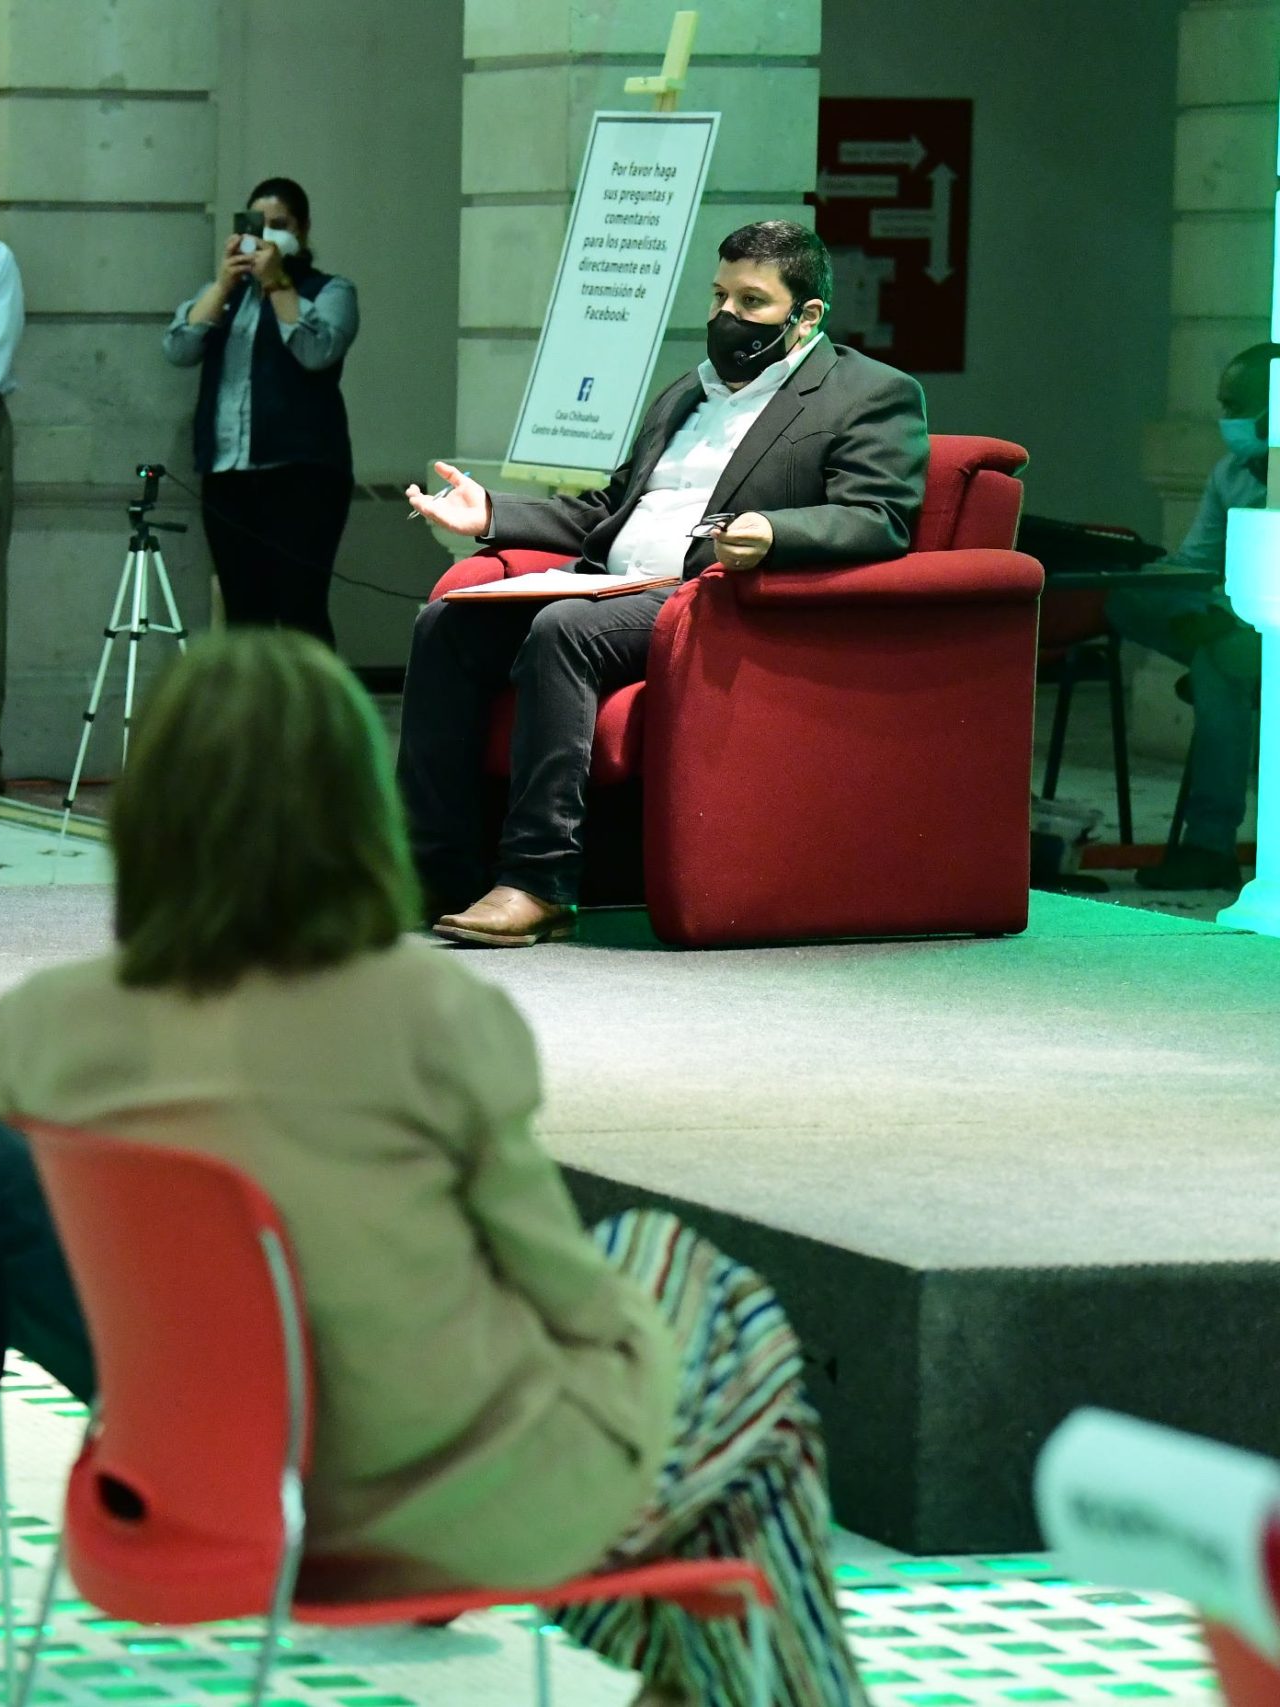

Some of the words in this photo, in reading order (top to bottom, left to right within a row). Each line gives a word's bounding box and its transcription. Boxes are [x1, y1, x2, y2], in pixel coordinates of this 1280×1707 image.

[611, 162, 627, 176] Por
[628, 162, 653, 177] favor
[654, 163, 677, 181] haga
[603, 189, 618, 200] sus
[618, 189, 666, 205] preguntas
[666, 191, 674, 206] y
[604, 211, 661, 226] comentarios
[583, 236, 604, 251] para
[606, 233, 619, 249] los
[579, 257, 638, 274] directamente
[639, 263, 651, 275] en
[652, 260, 661, 275] la
[581, 281, 633, 297] transmisión
[634, 283, 646, 299] de
